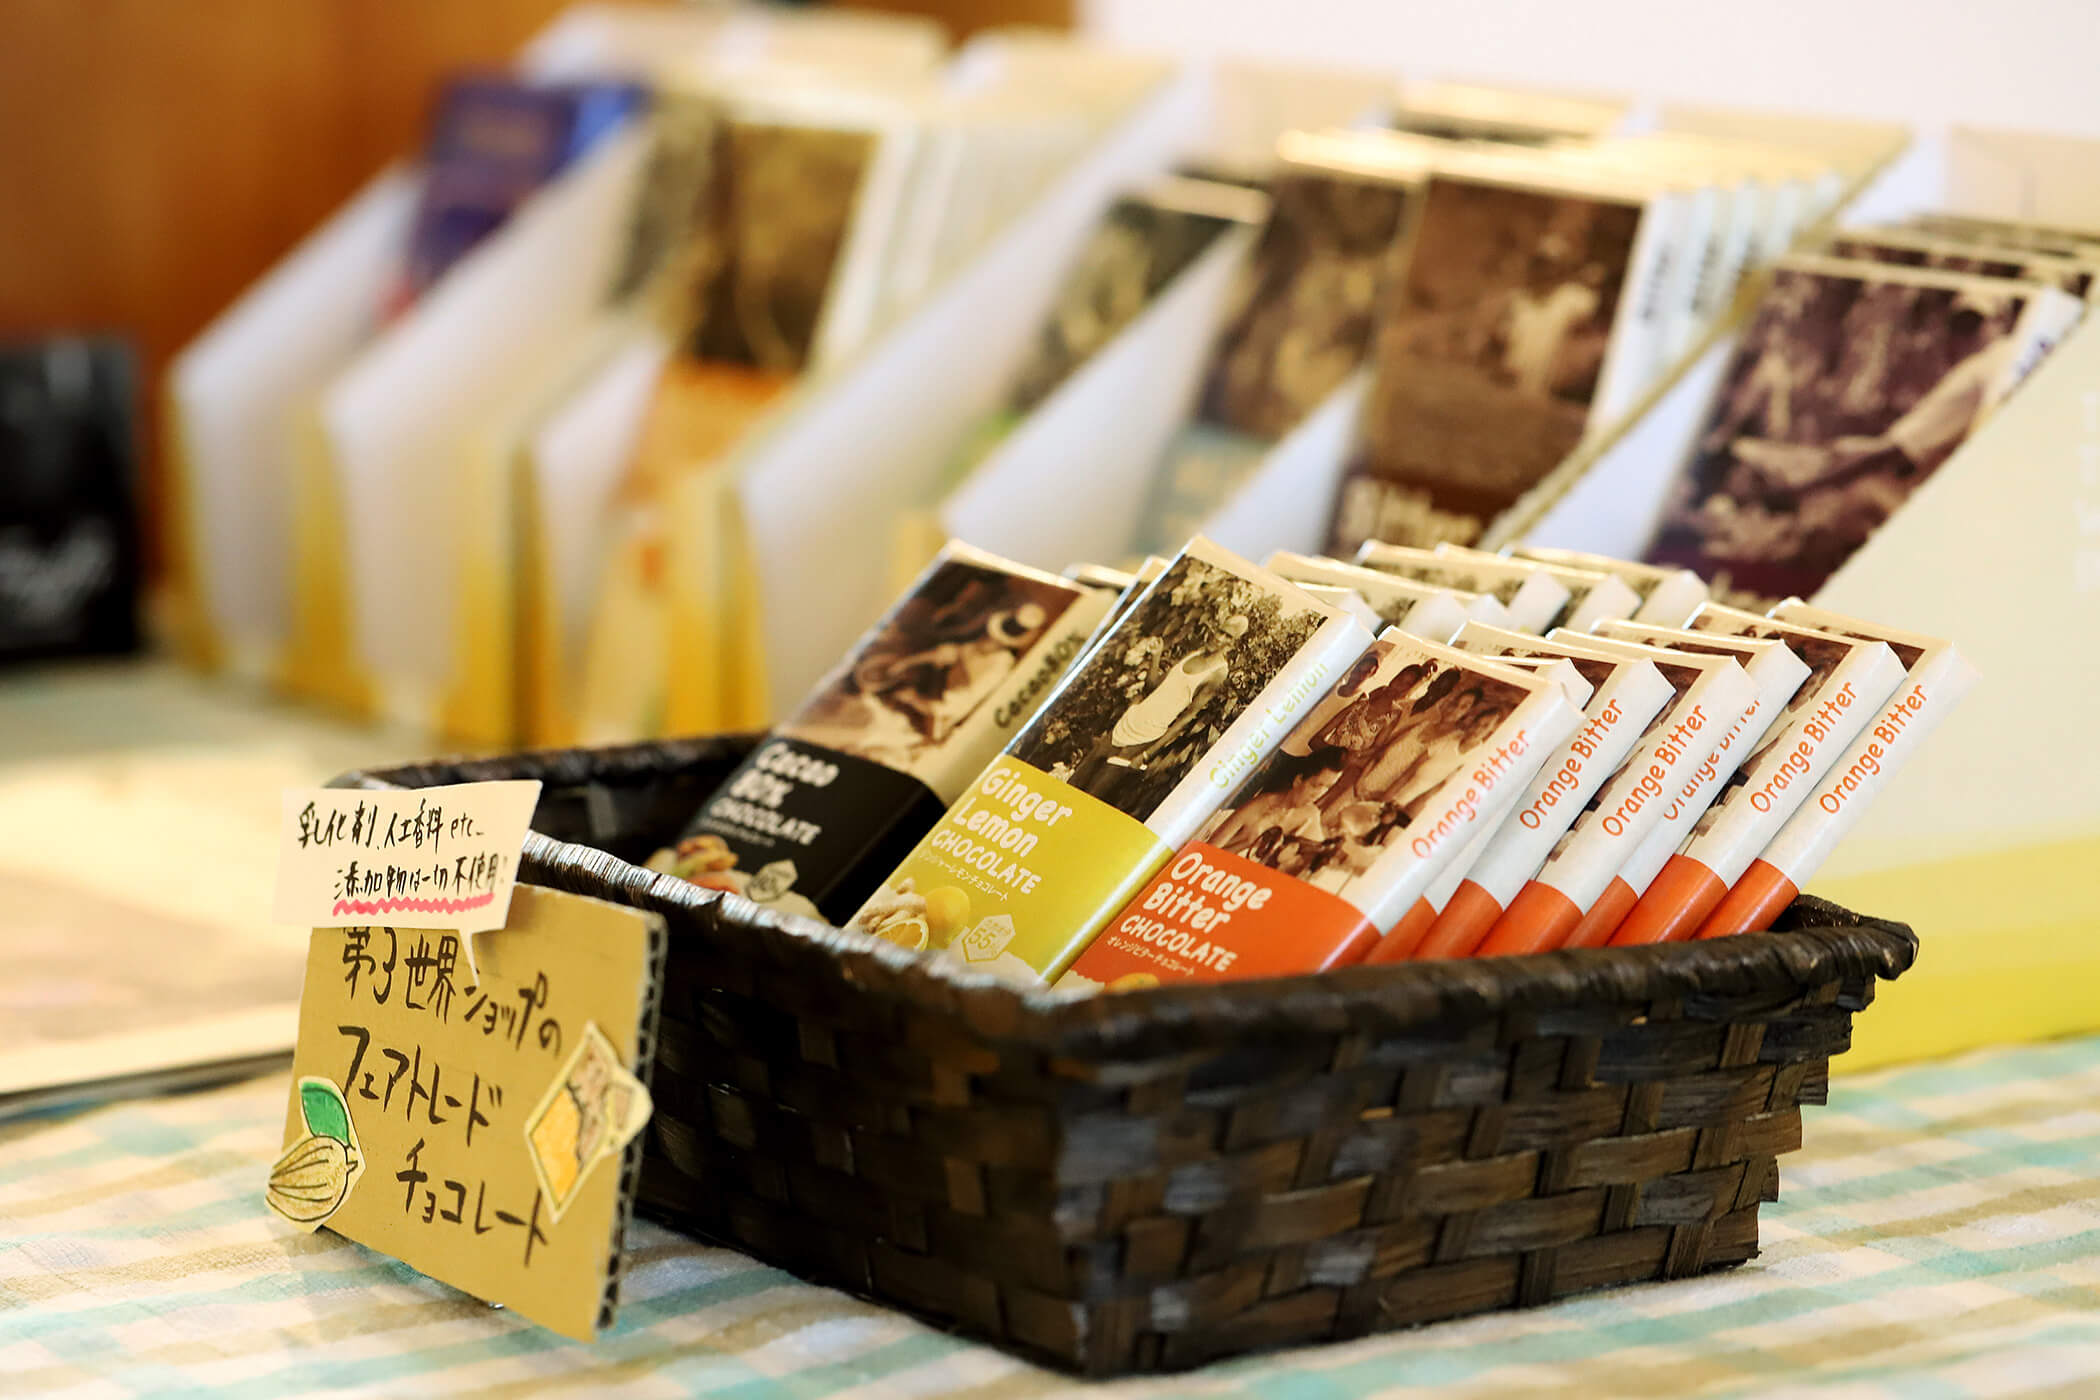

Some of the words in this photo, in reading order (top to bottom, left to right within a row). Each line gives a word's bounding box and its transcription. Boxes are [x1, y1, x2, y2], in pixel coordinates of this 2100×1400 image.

[981, 767, 1073, 827] Ginger
[1411, 788, 1481, 860] Orange
[1473, 729, 1530, 792] Bitter
[1519, 757, 1582, 830] Orange
[1571, 698, 1623, 760] Bitter
[1602, 763, 1666, 837] Orange
[1655, 704, 1708, 768] Bitter
[1750, 741, 1815, 814] Orange
[1803, 681, 1857, 744] Bitter
[1819, 742, 1885, 815] Orange
[1873, 684, 1927, 745] Bitter
[931, 829, 1043, 895] CHOCOLATE
[952, 797, 1039, 858] Lemon
[1170, 852, 1273, 912] Orange
[1119, 914, 1238, 972] CHOCOLATE
[1142, 882, 1231, 934] Bitter
[337, 1025, 503, 1148] フェアトレード
[395, 1137, 548, 1269] チョコレート
